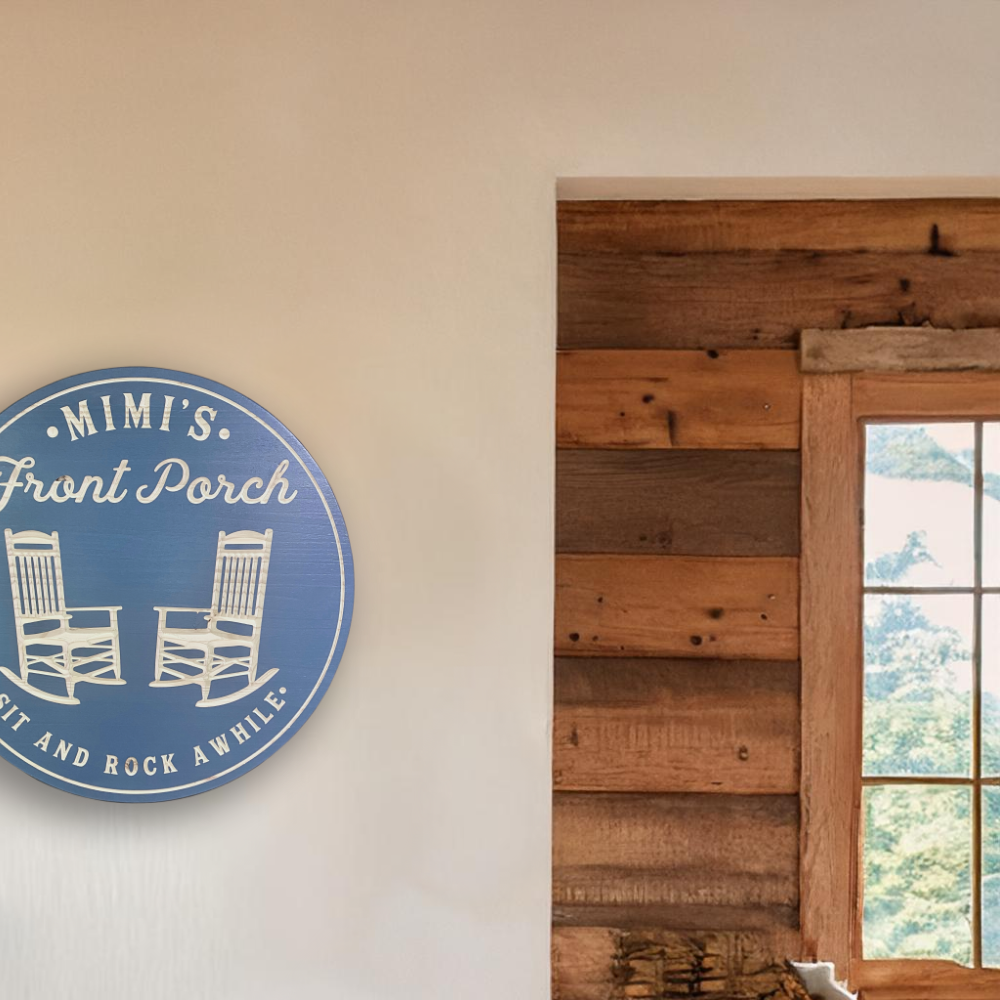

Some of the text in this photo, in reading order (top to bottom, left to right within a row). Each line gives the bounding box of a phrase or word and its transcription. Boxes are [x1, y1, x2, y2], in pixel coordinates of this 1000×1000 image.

[60, 392, 217, 441] MIMI'S
[135, 458, 298, 505] Porch
[33, 731, 90, 768] AND
[104, 753, 178, 776] ROCK
[194, 691, 287, 766] AWHILE
